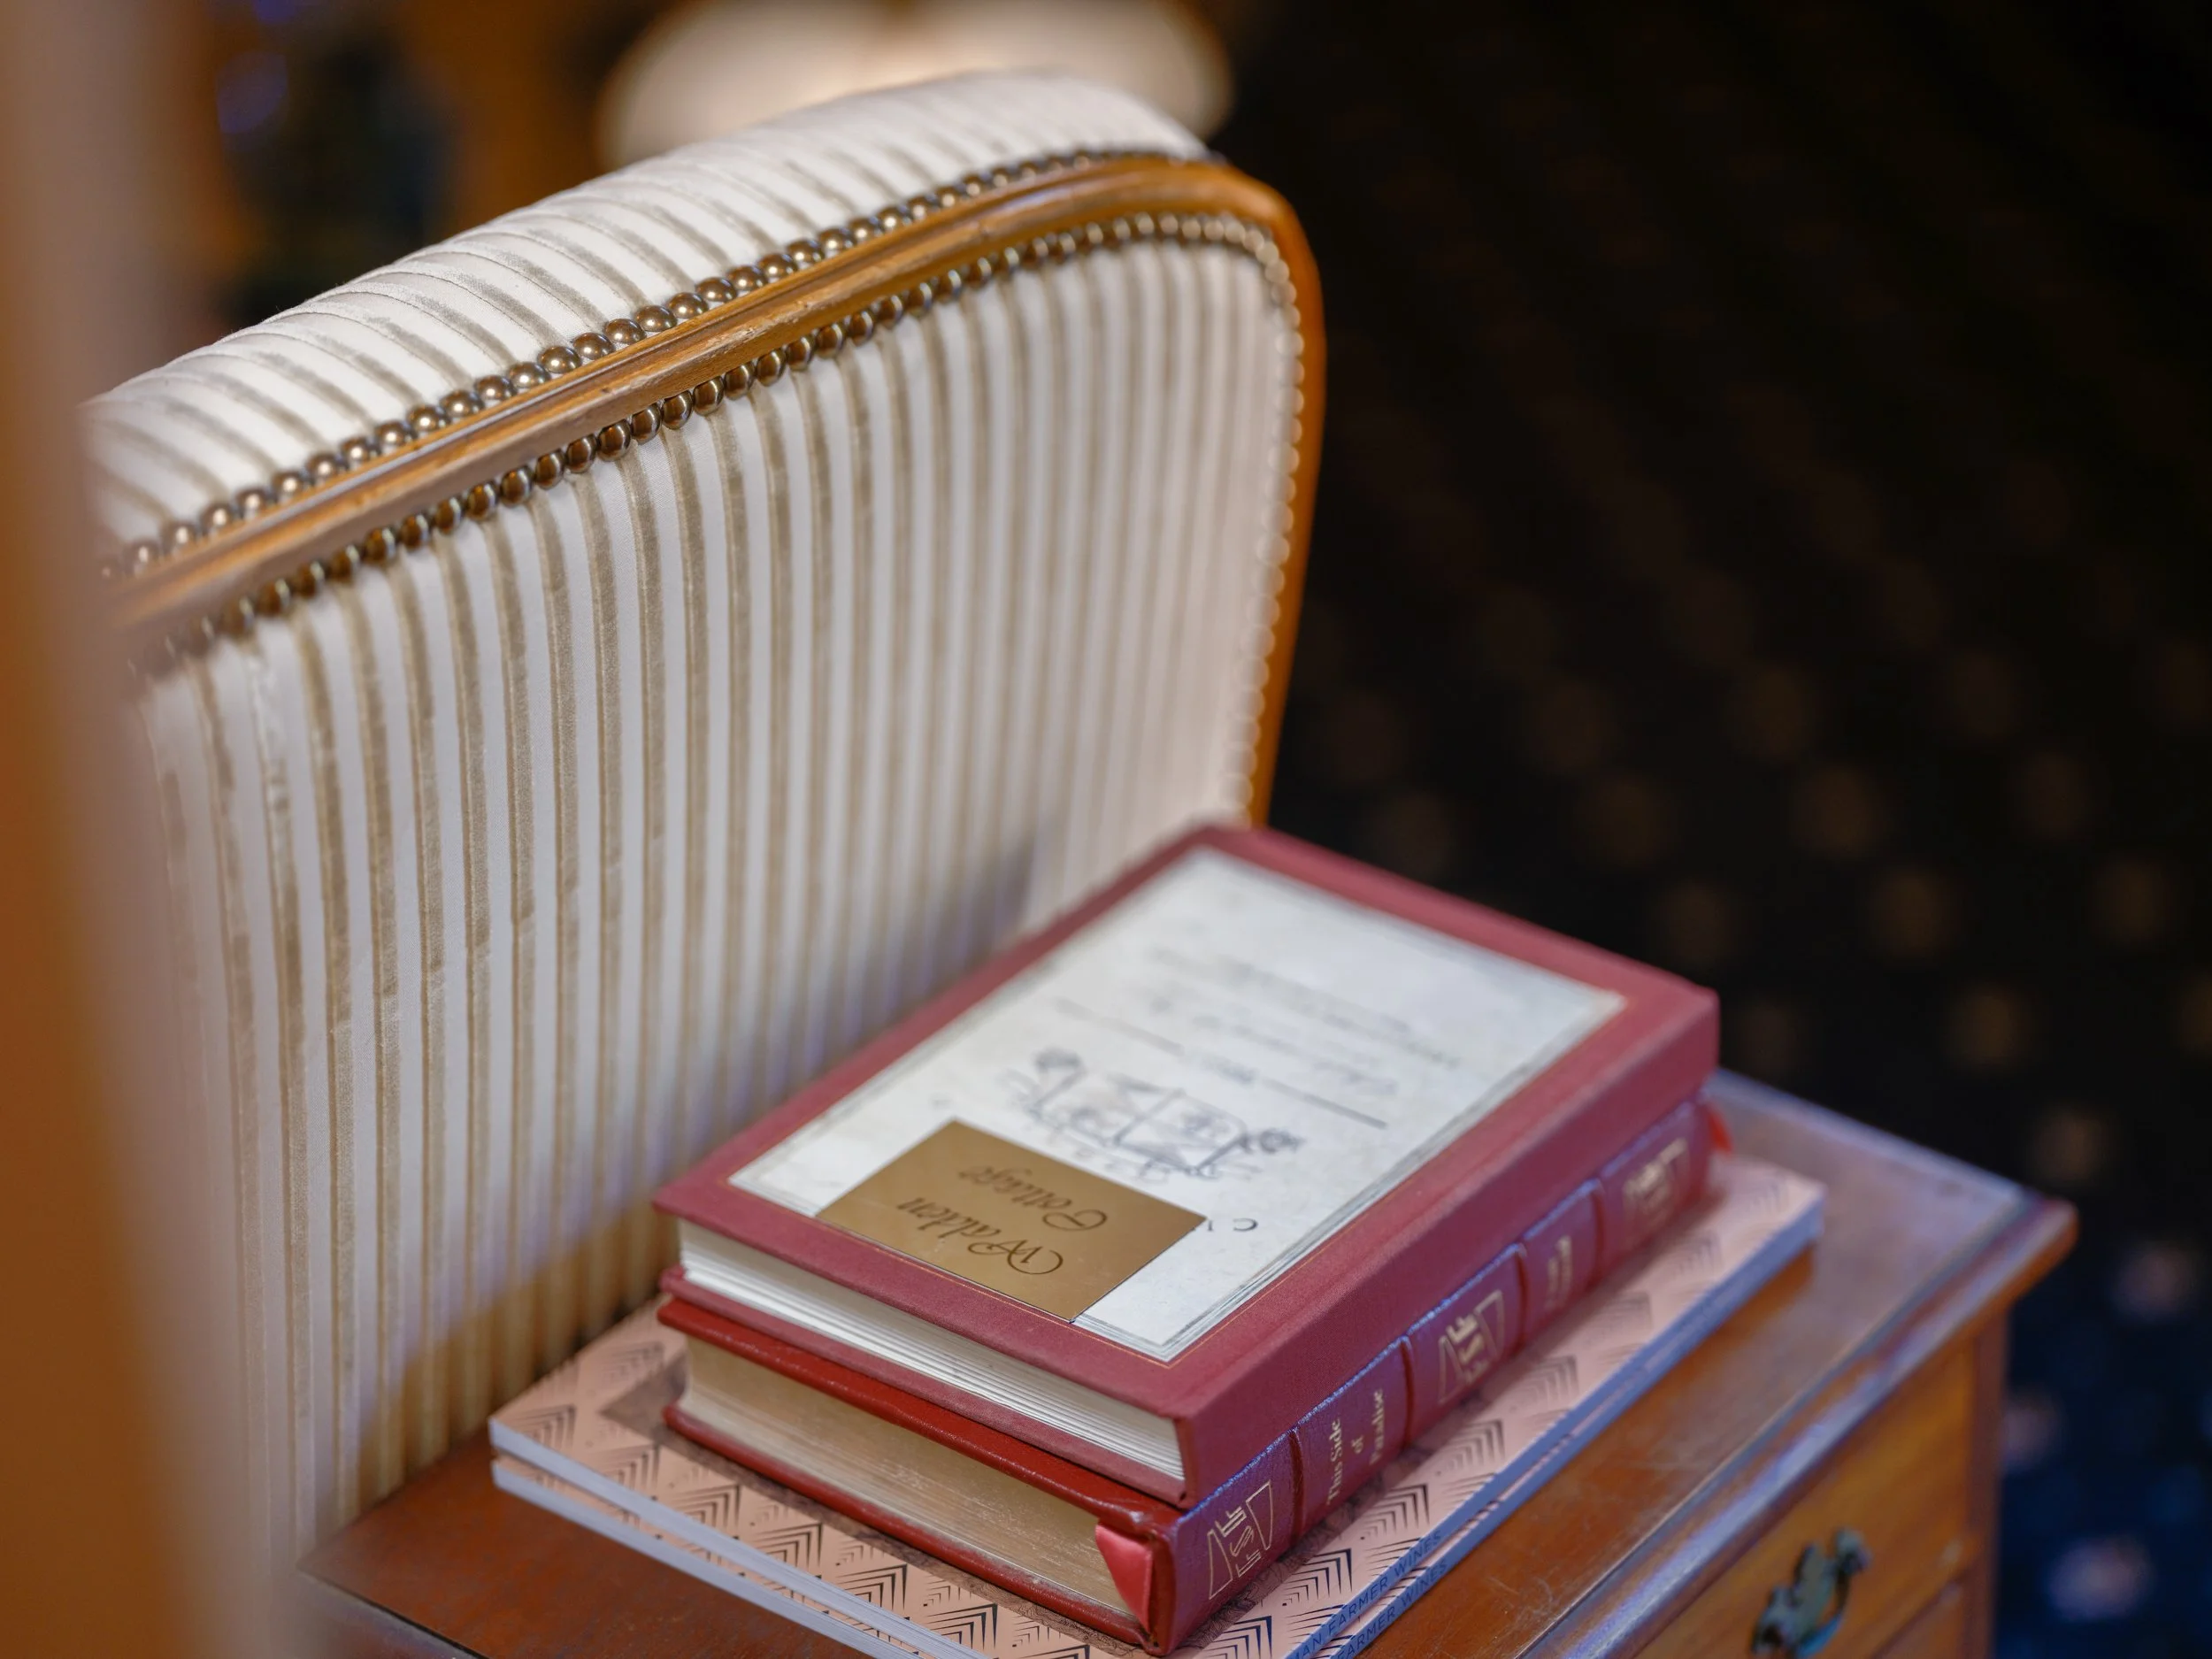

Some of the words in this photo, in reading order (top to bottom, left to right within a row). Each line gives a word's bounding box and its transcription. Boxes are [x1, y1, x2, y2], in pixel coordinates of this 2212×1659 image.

[959, 1166, 1108, 1232] Cottage
[896, 1196, 1064, 1276] Walden
[1329, 1418, 1343, 1462] Side
[1350, 1434, 1363, 1455] of
[1327, 1462, 1343, 1504] This
[1328, 1576, 1389, 1635] FARMER
[1394, 1530, 1442, 1578] WINES
[1337, 1606, 1396, 1659] FARMER
[1402, 1562, 1448, 1608] WINES
